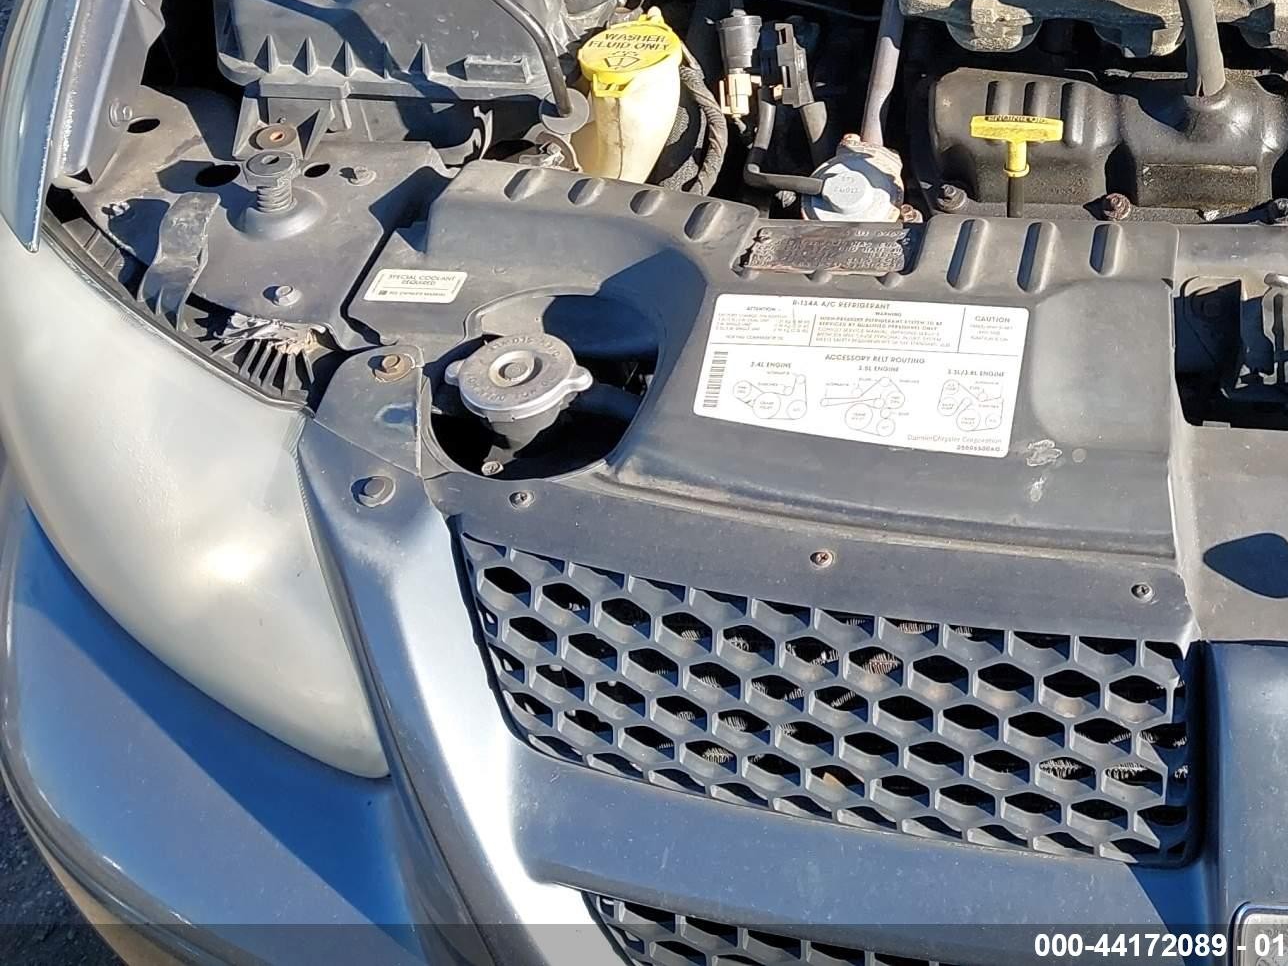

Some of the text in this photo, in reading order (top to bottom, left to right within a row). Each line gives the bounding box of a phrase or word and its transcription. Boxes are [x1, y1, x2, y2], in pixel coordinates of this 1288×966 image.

[604, 33, 667, 44] WASHER
[588, 40, 670, 52] FLUID ONLY
[792, 299, 818, 307] R-134A
[838, 302, 891, 310] REFRIGERANT
[974, 315, 1011, 323] CAUTION
[825, 354, 926, 364] ACCESSORY BELT ROUTING
[766, 361, 792, 369] ENGINE
[907, 434, 1002, 444] DaimlerChrysler Corporation
